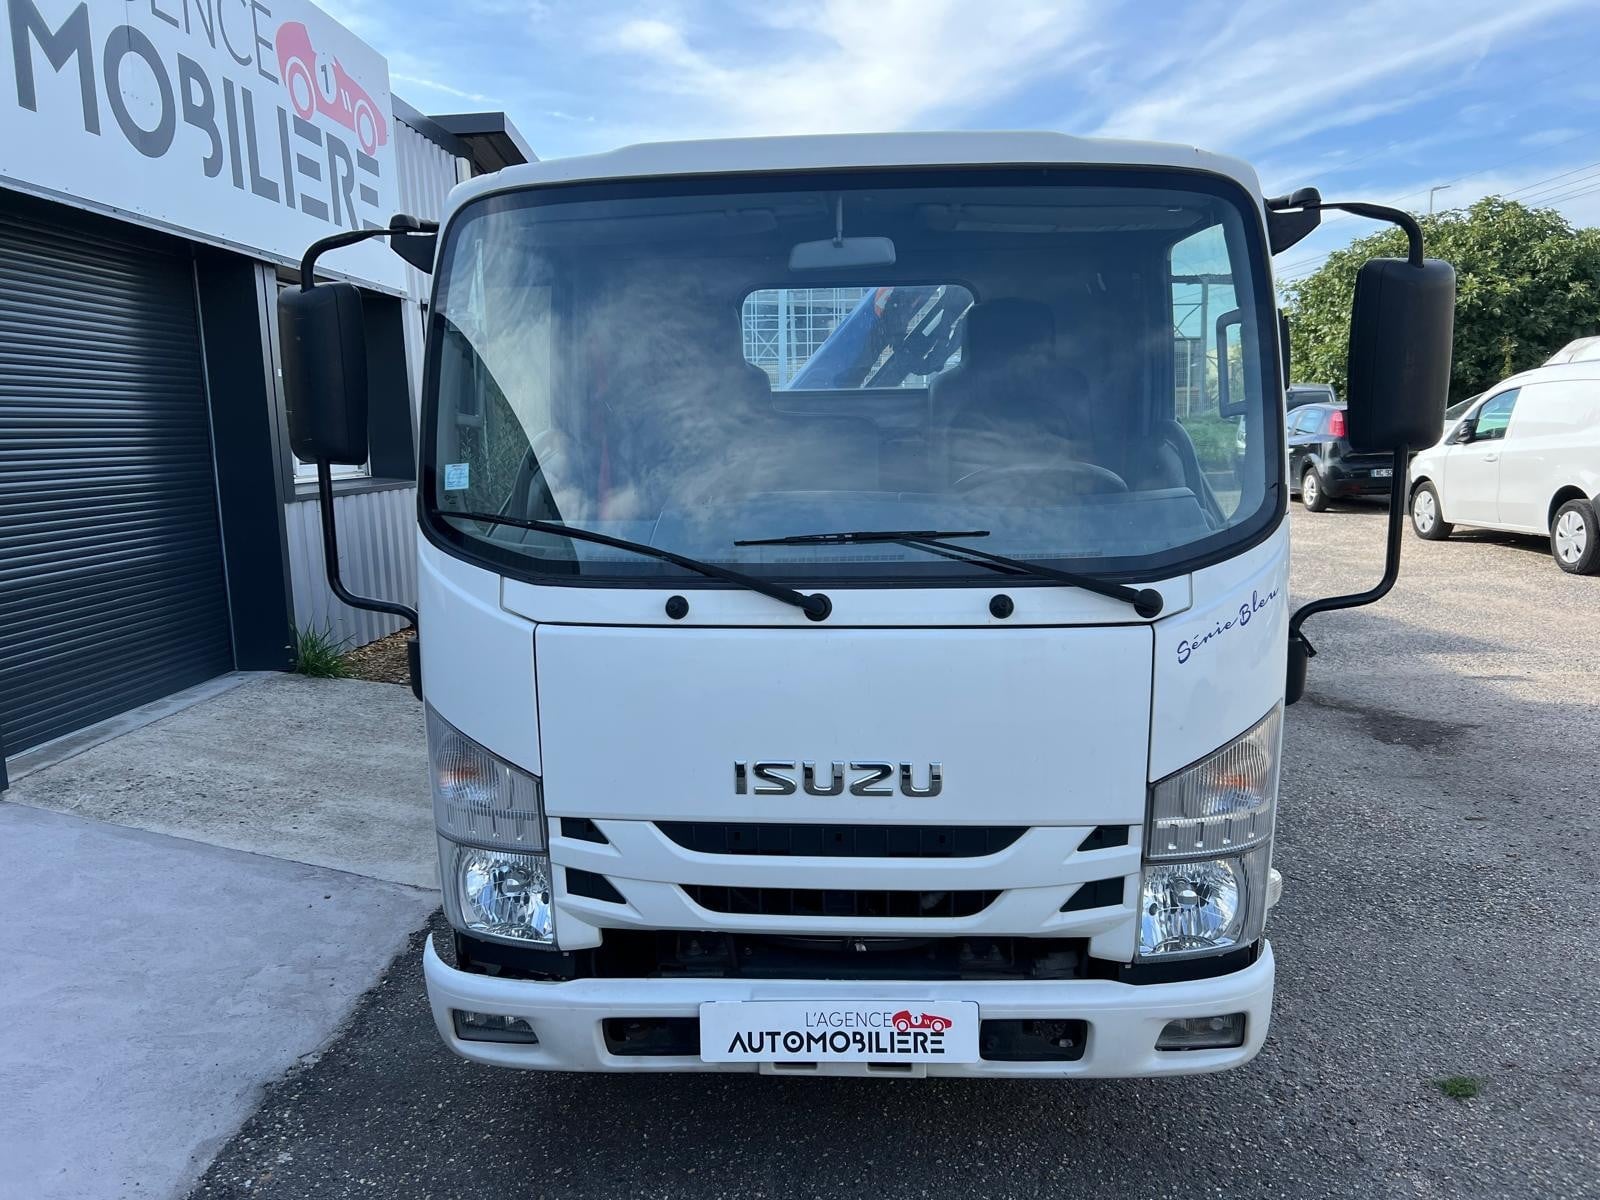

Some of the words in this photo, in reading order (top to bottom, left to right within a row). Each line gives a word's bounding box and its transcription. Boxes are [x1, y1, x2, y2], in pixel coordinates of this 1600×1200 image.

[7, 0, 385, 243] MOBILIERE
[735, 760, 943, 797] ISUZU
[805, 1011, 893, 1028] L'AGENCE
[728, 1030, 945, 1054] AUTOMOBILIERE
